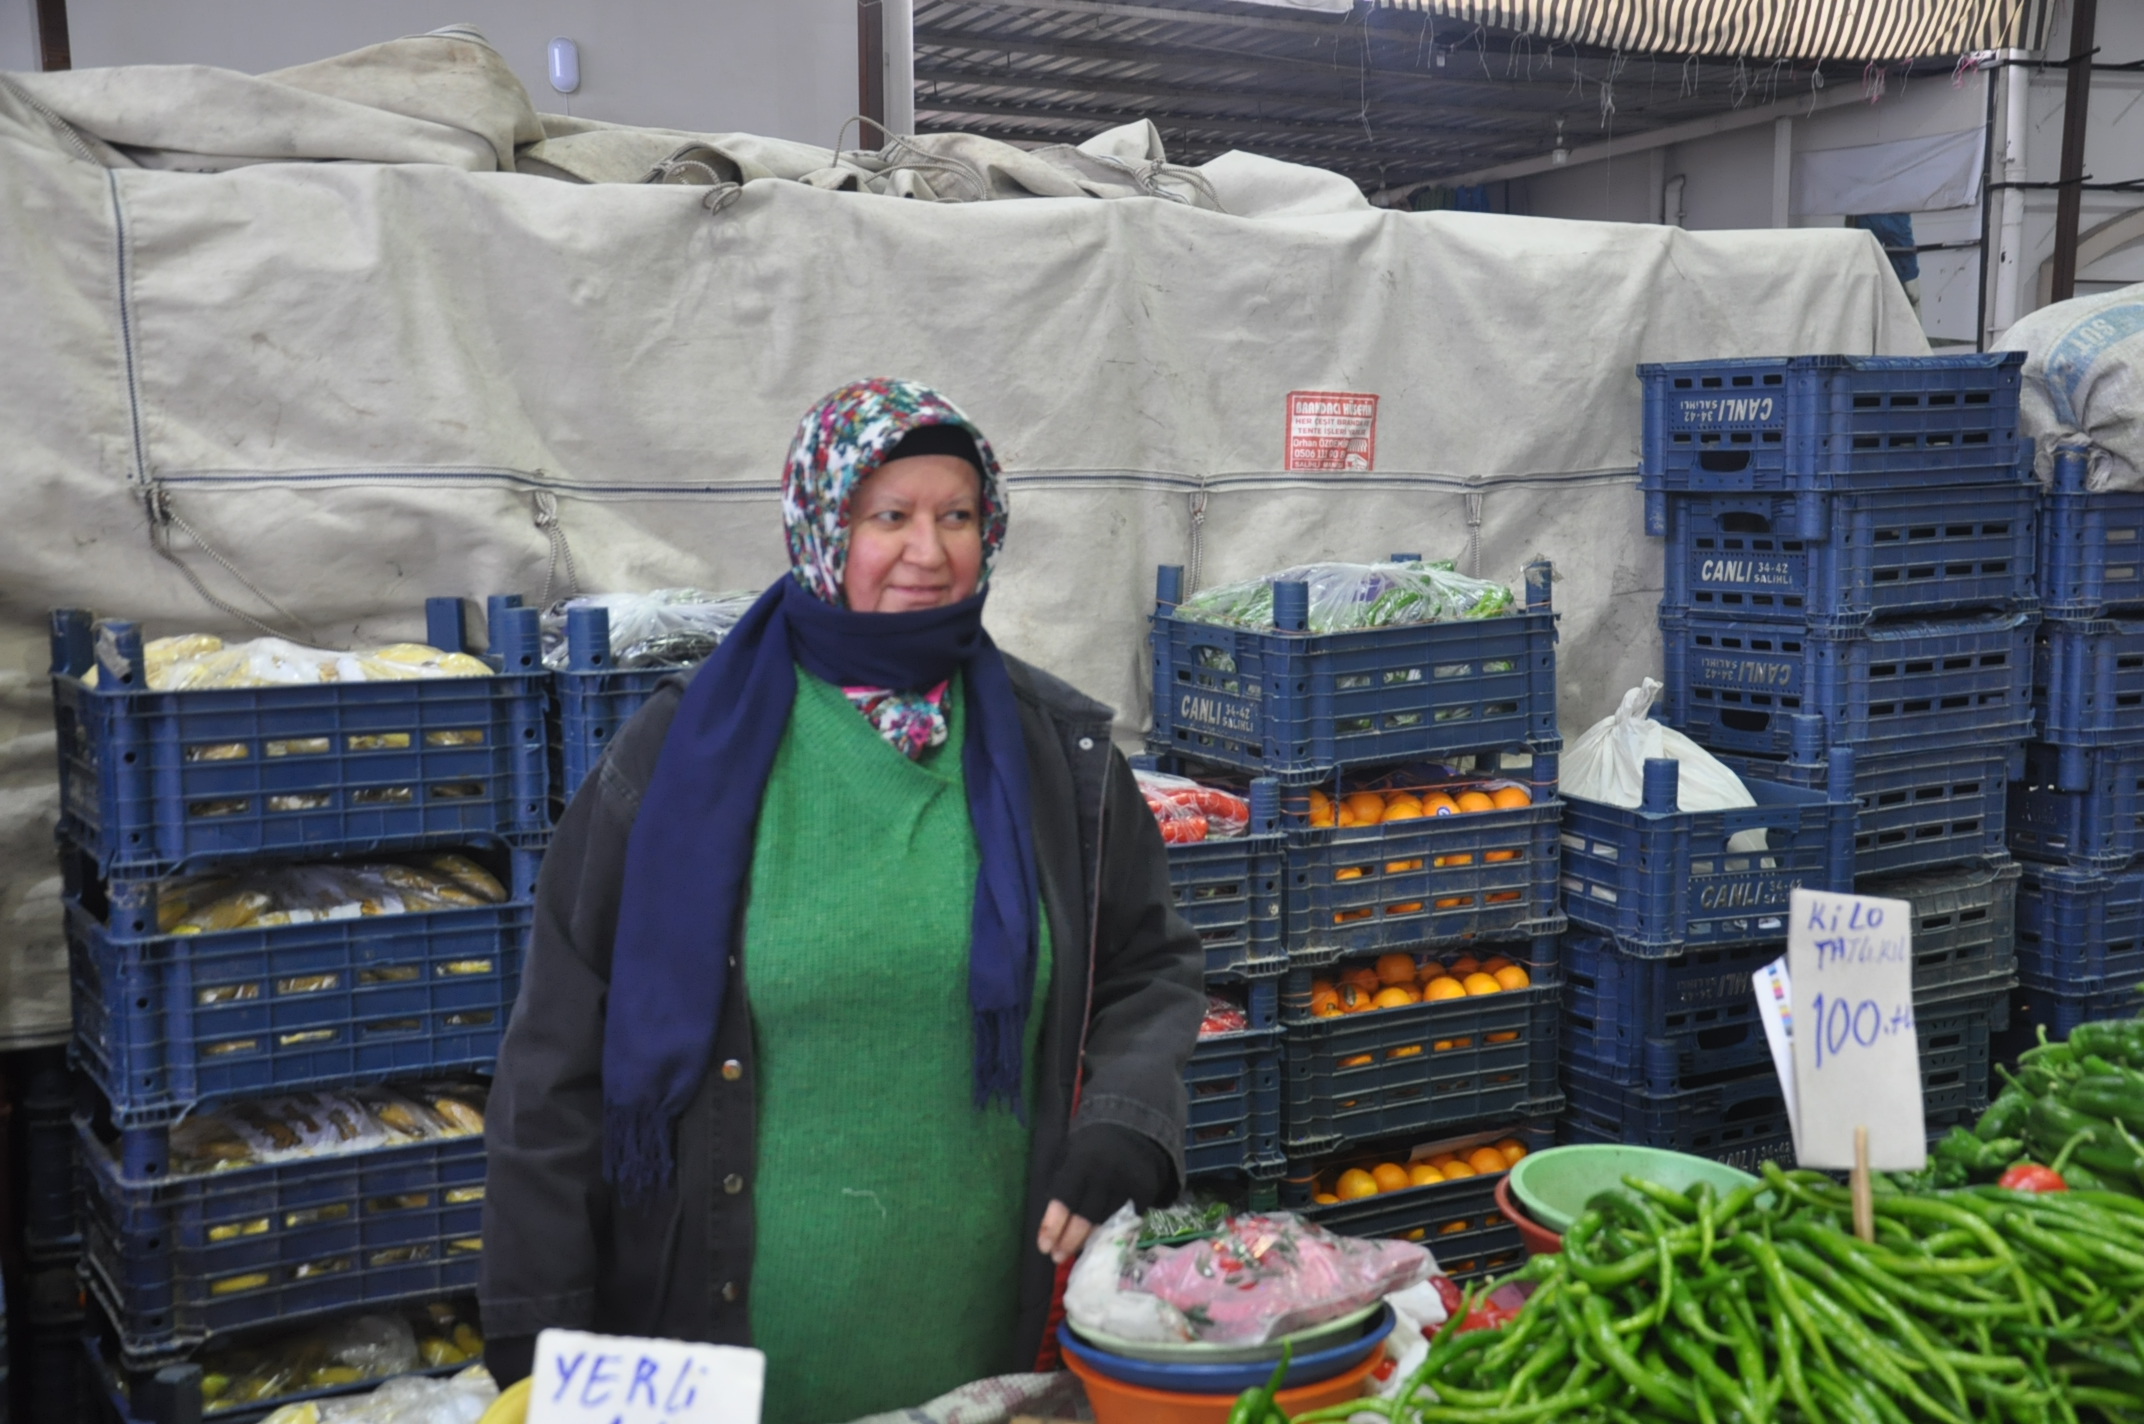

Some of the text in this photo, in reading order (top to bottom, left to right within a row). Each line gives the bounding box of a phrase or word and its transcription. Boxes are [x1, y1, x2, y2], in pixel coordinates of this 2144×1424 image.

[1717, 397, 1773, 422] CANLI
[1293, 438, 1317, 447] Orhan
[1701, 559, 1753, 582] CANLI
[1758, 562, 1788, 574] 34-42
[1738, 661, 1792, 686] CANLI
[1181, 695, 1222, 725] CANLI
[1701, 881, 1764, 909] CANLI
